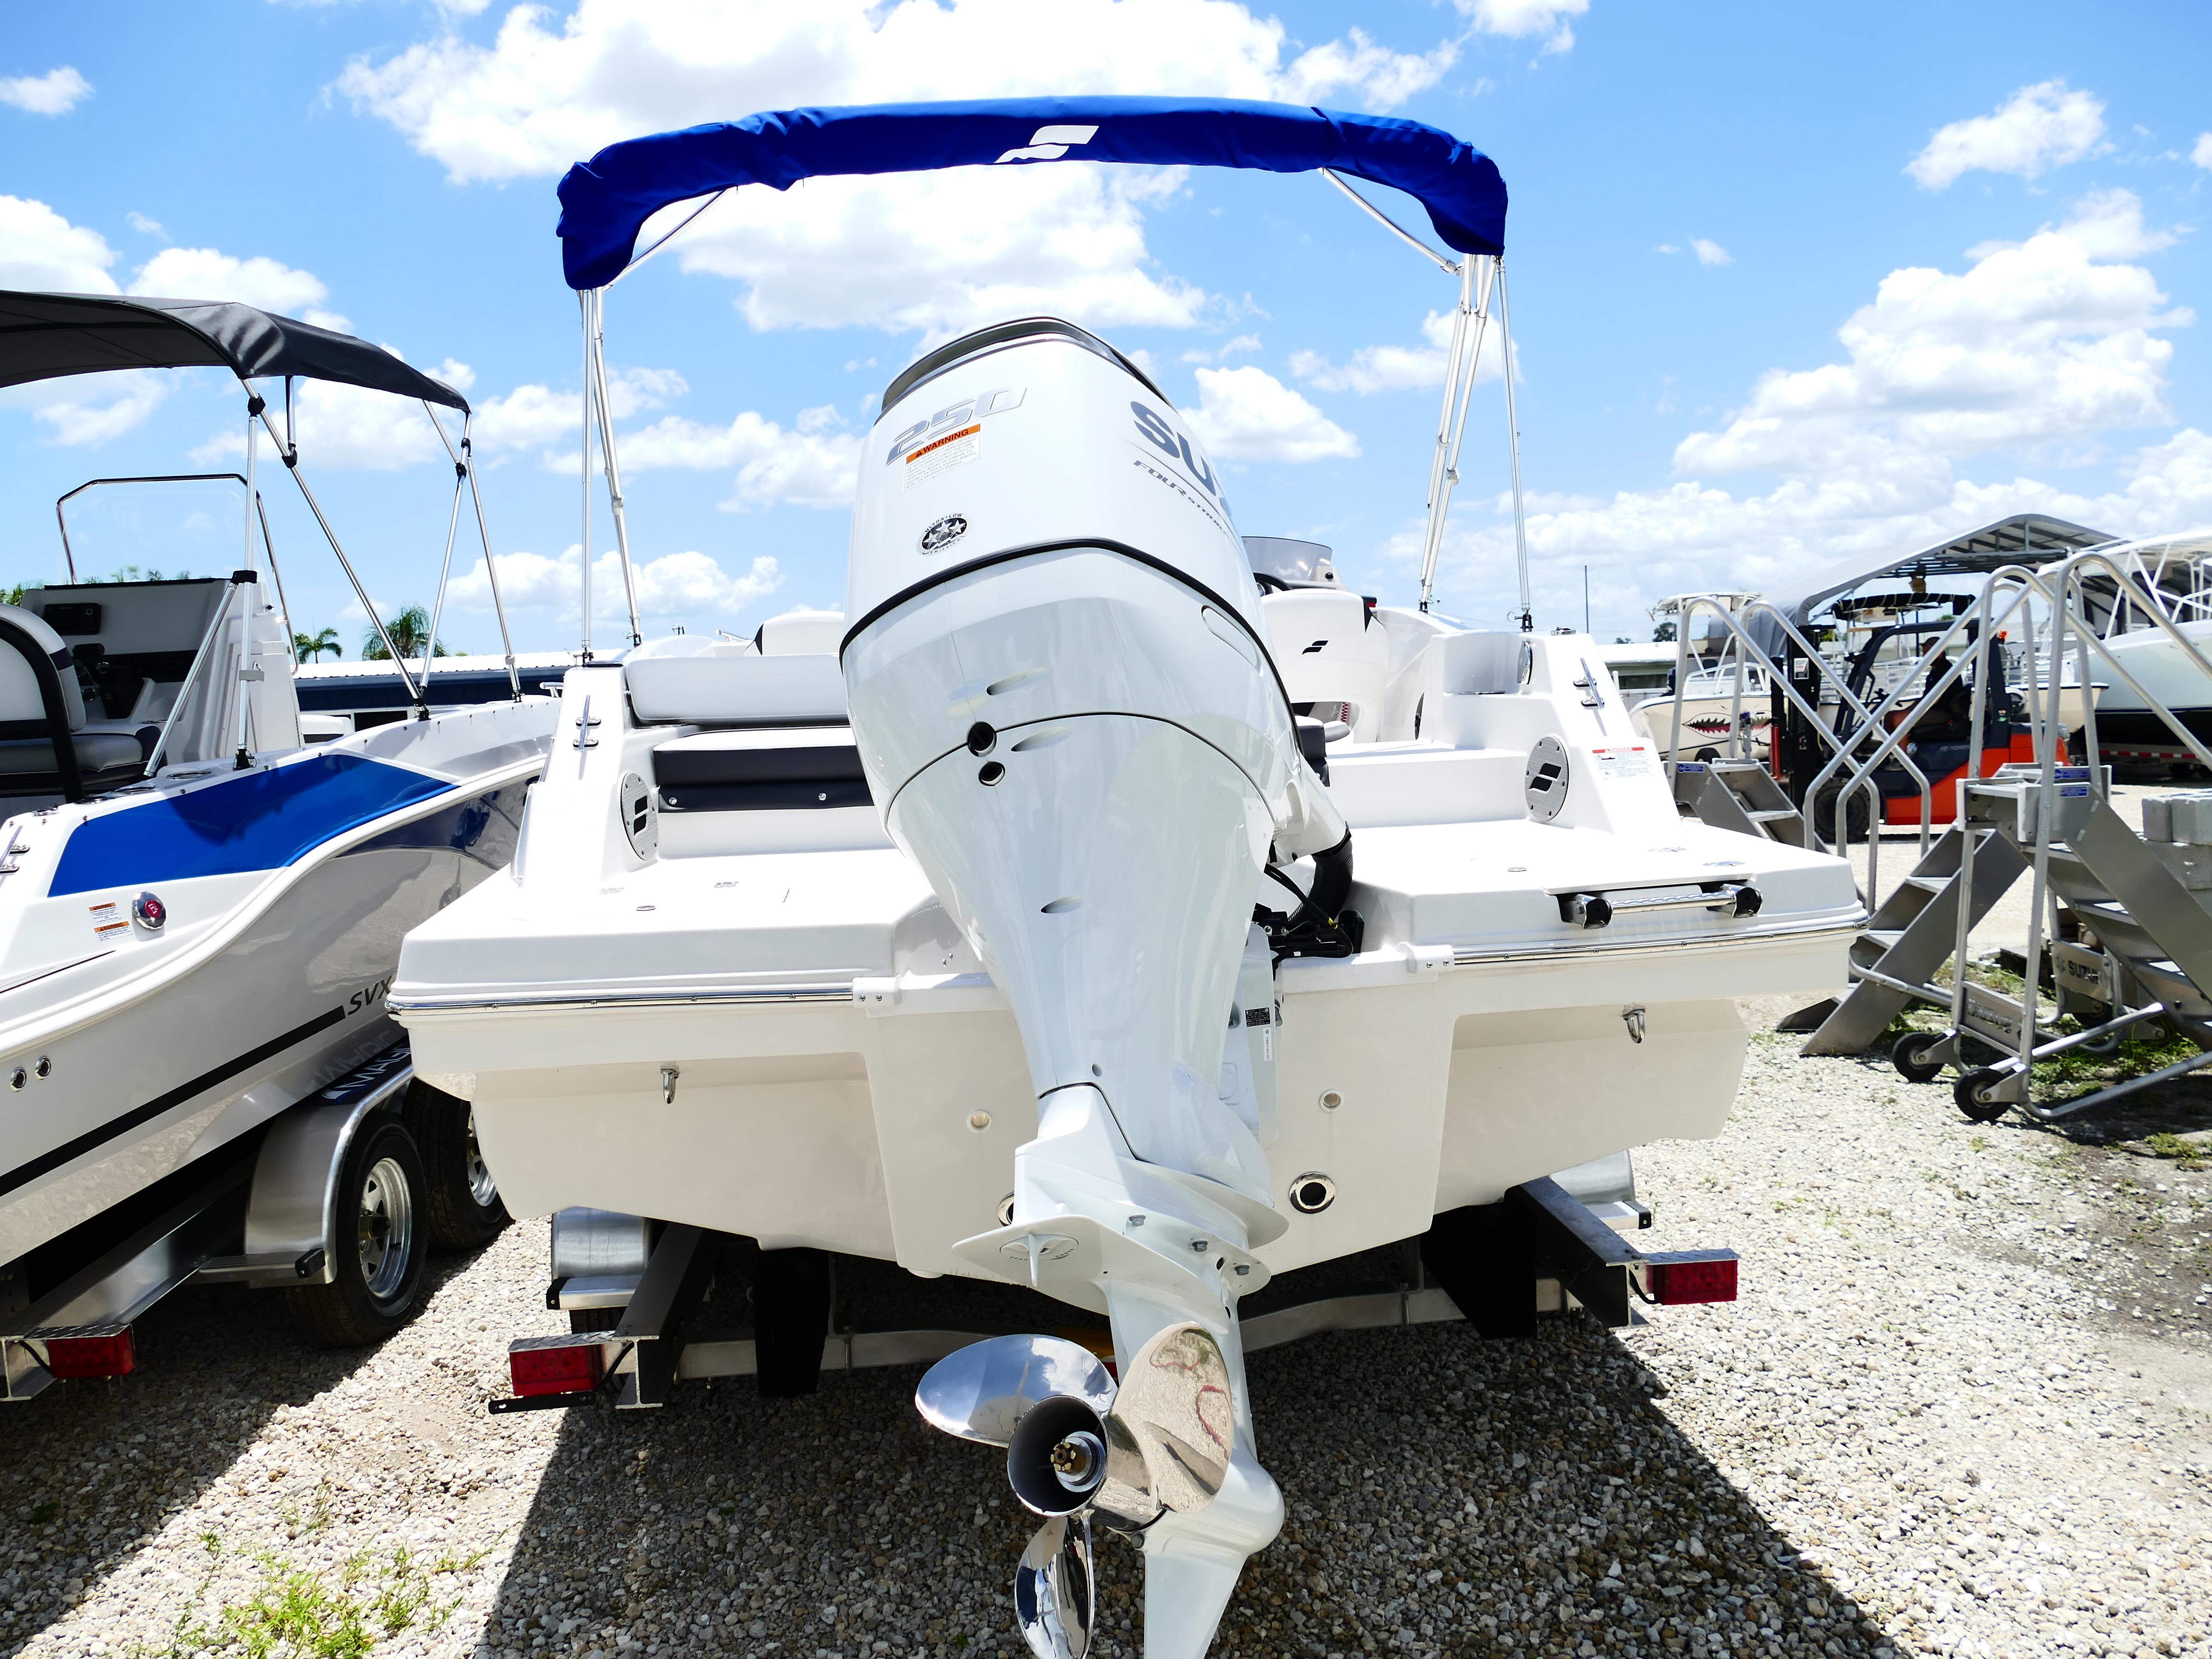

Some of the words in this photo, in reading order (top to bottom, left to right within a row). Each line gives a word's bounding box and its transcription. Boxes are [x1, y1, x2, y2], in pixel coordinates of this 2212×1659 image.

[885, 386, 1027, 466] 250
[923, 429, 969, 453] WARNING
[1133, 460, 1187, 498] FOUR
[348, 975, 392, 1016] SVX
